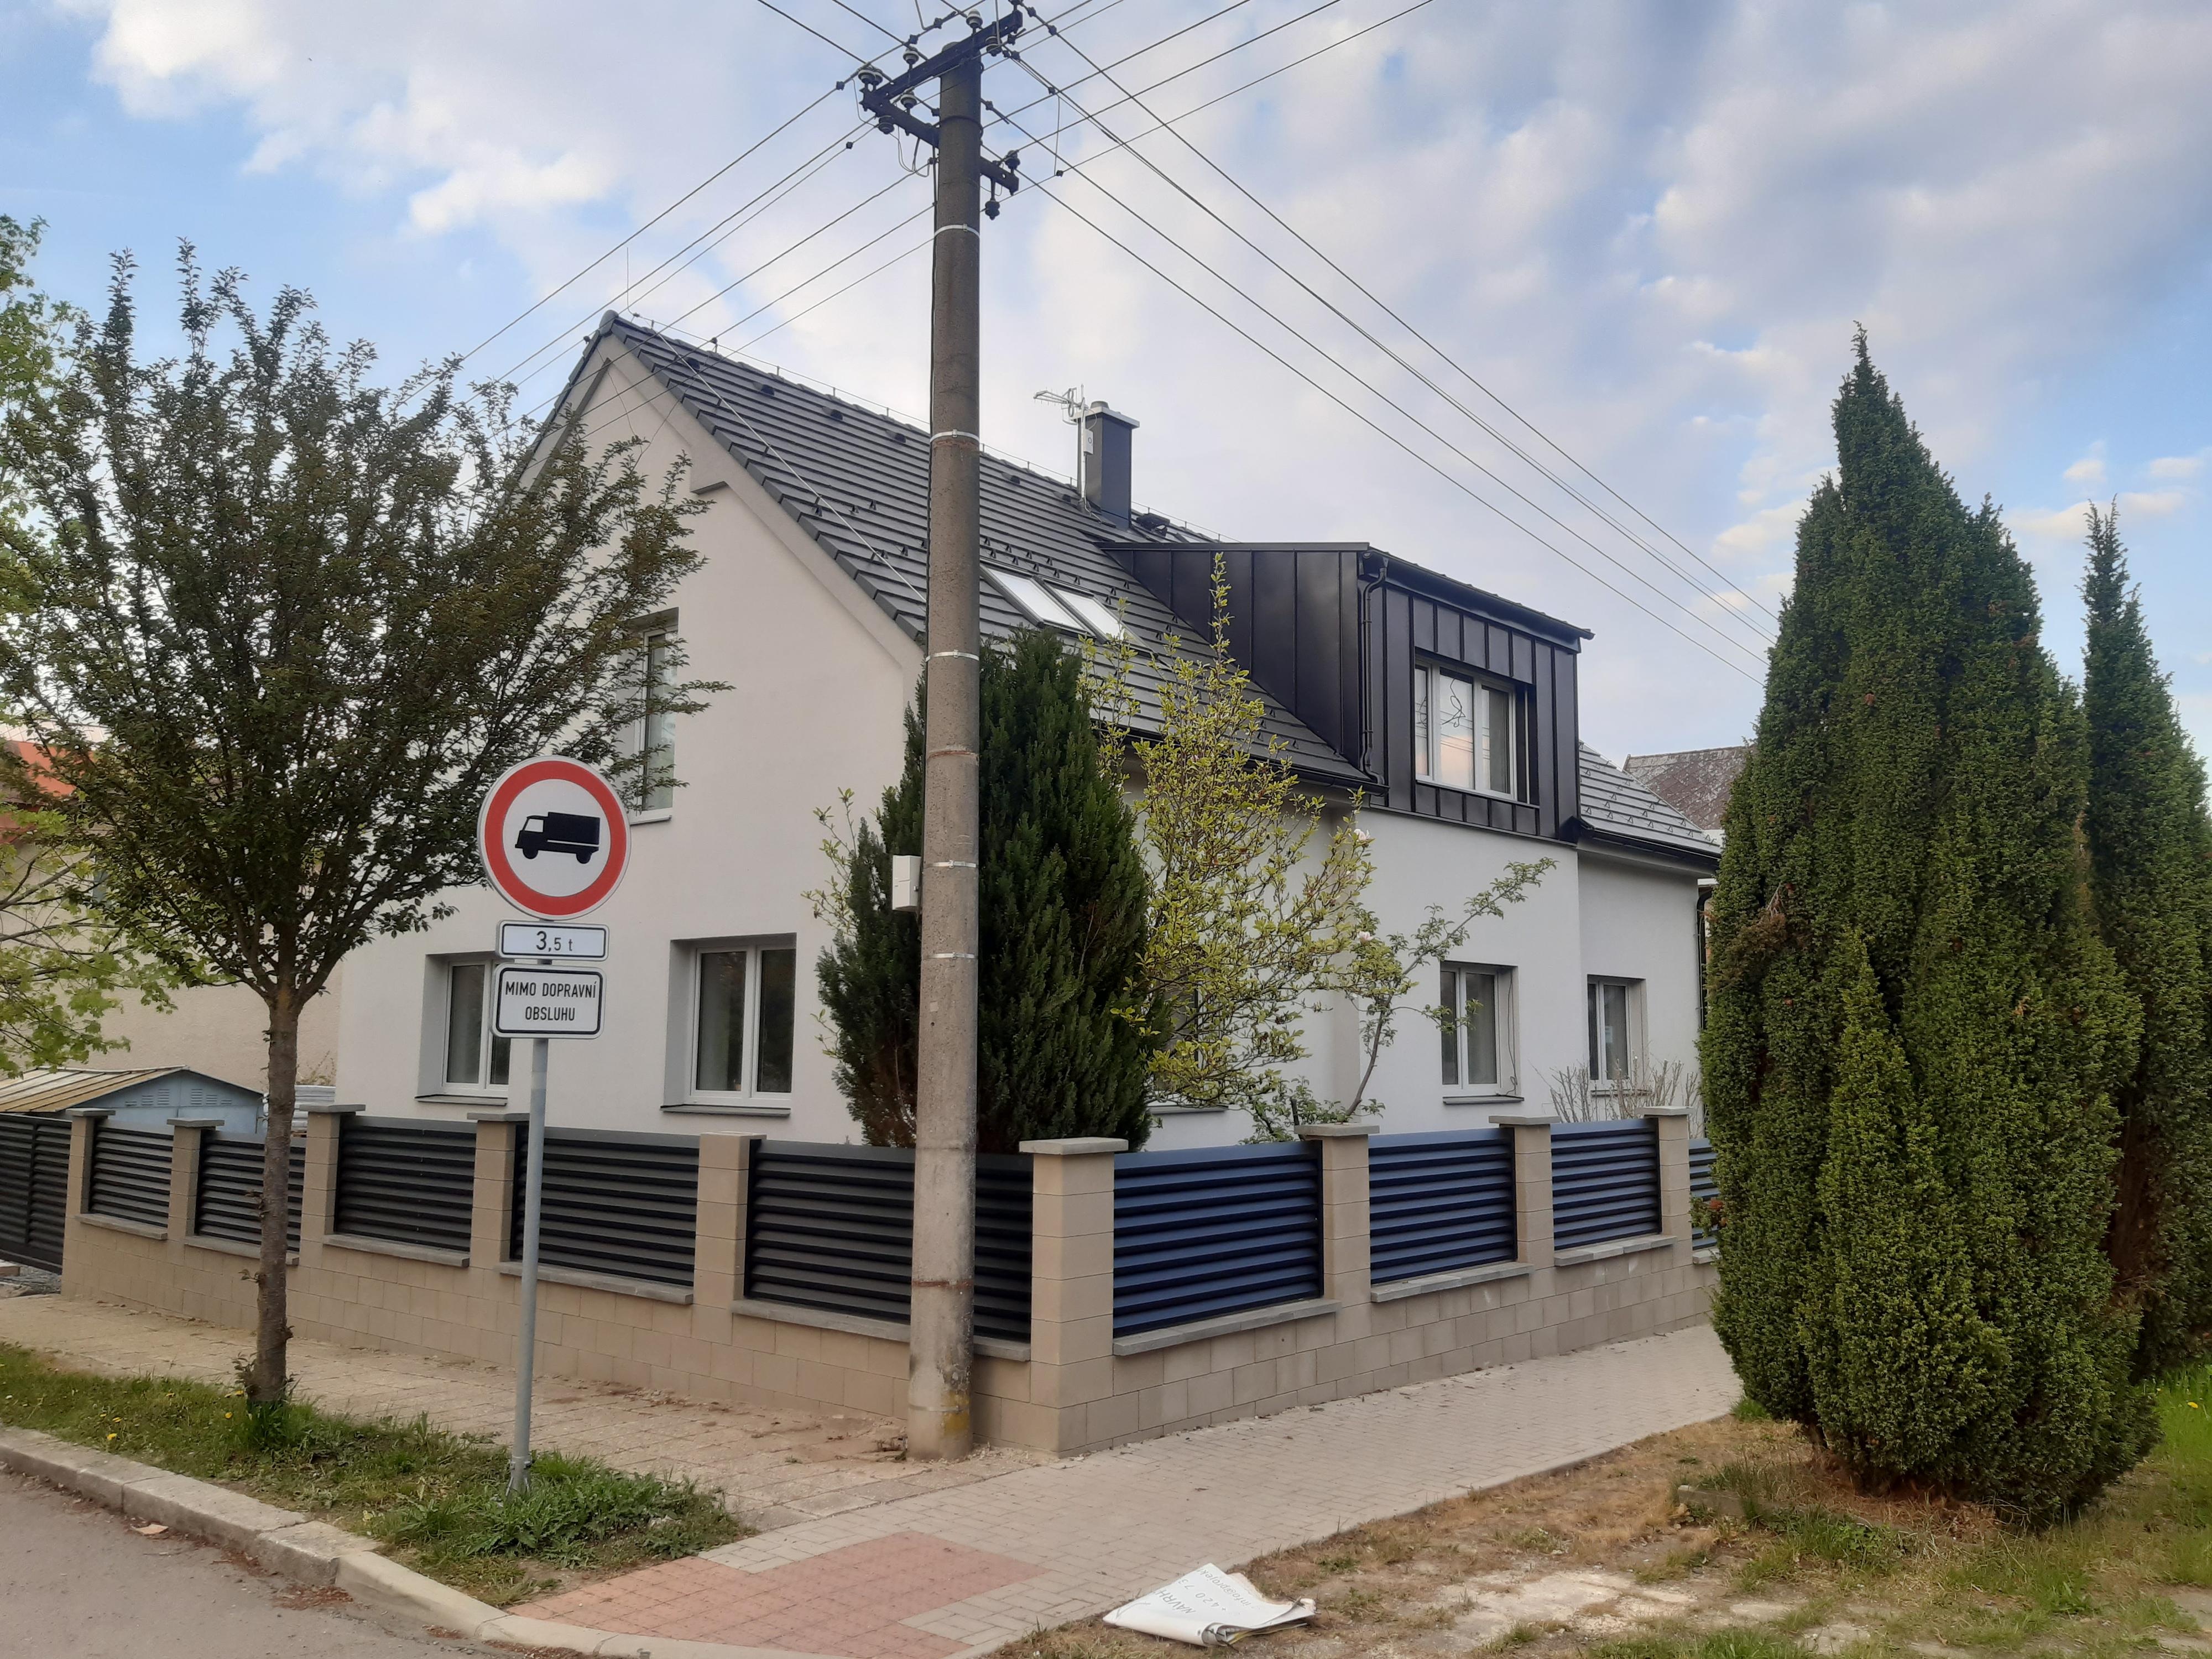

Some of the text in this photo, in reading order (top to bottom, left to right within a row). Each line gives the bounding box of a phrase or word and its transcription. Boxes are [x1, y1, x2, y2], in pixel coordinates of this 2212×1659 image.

[536, 931, 573, 952] 3,5 t
[505, 981, 597, 998] MIMO DOPRAVNÍ
[525, 1006, 575, 1021] OBSLUHU
